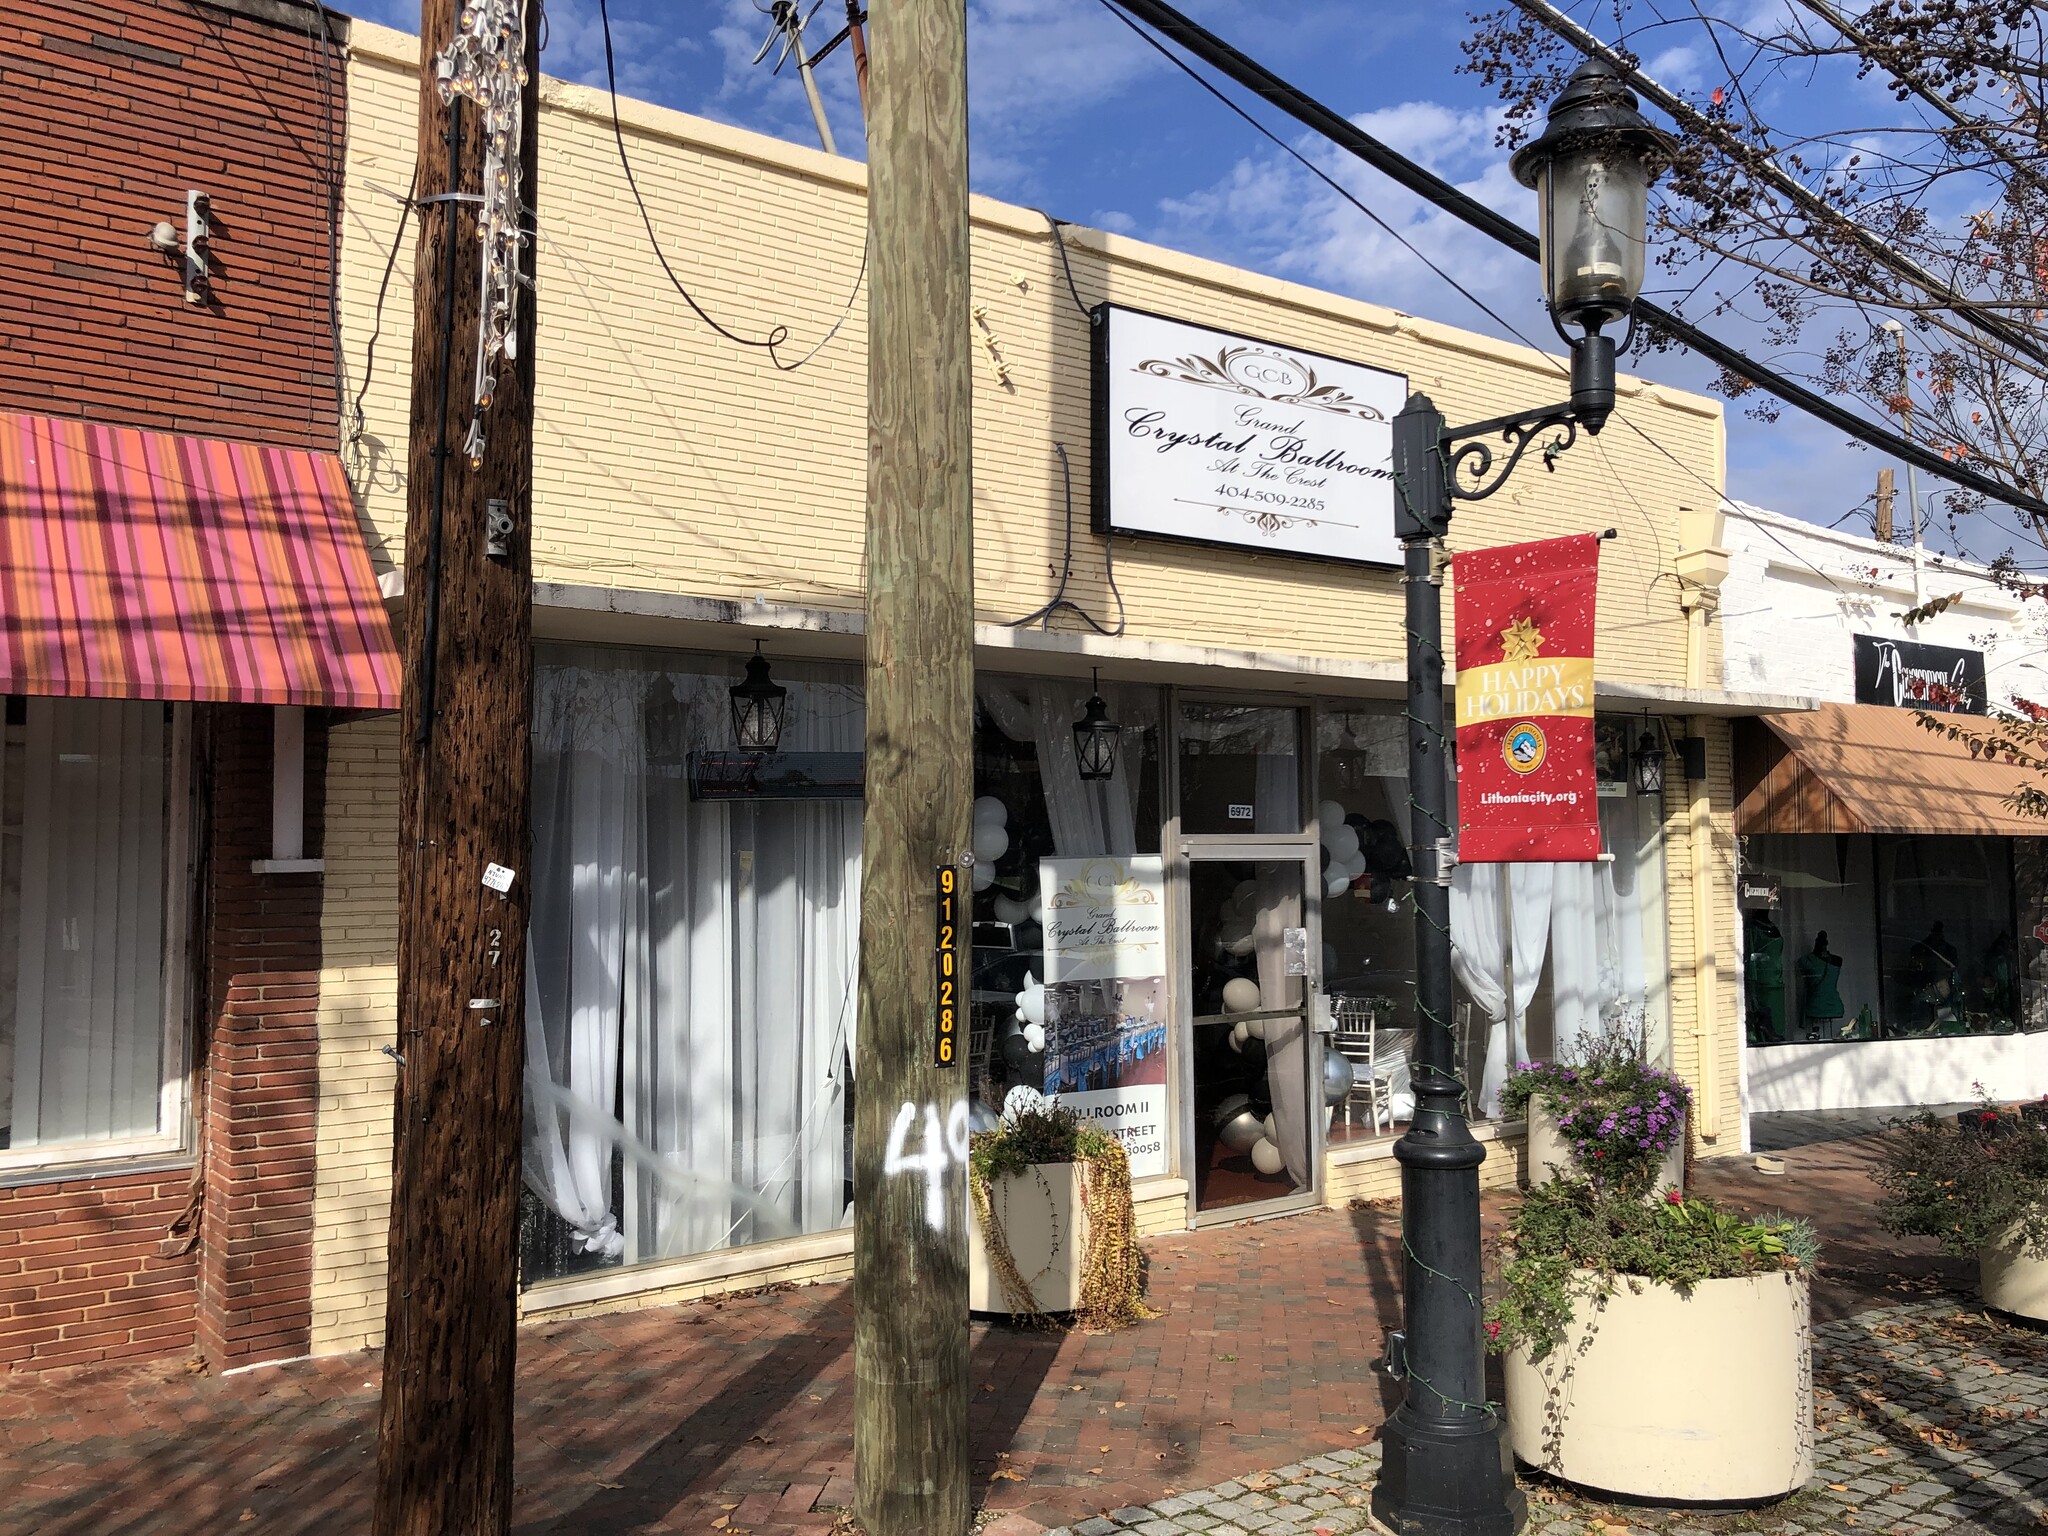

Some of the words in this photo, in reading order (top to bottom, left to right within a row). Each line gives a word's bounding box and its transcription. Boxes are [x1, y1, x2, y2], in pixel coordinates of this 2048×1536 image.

[1244, 364, 1292, 385] GCB
[1234, 404, 1305, 434] Grand
[1124, 407, 1257, 453] Crystal
[1259, 435, 1395, 481] Ballroom
[1206, 457, 1240, 473] At
[1242, 461, 1279, 481] The
[1283, 466, 1327, 488] Crest
[1214, 484, 1325, 511] 404-509-2285
[1482, 663, 1566, 693] HAPPY
[1467, 684, 1585, 717] HOLIDAYS
[1481, 791, 1577, 805] Lithoniacity.org
[1230, 806, 1251, 817] 6972
[1087, 907, 1117, 919] Grand
[1047, 921, 1098, 943] Crystal
[1098, 918, 1160, 935] Ballroom
[1112, 1125, 1157, 1140] STREET
[1127, 1141, 1161, 1156] 30058
